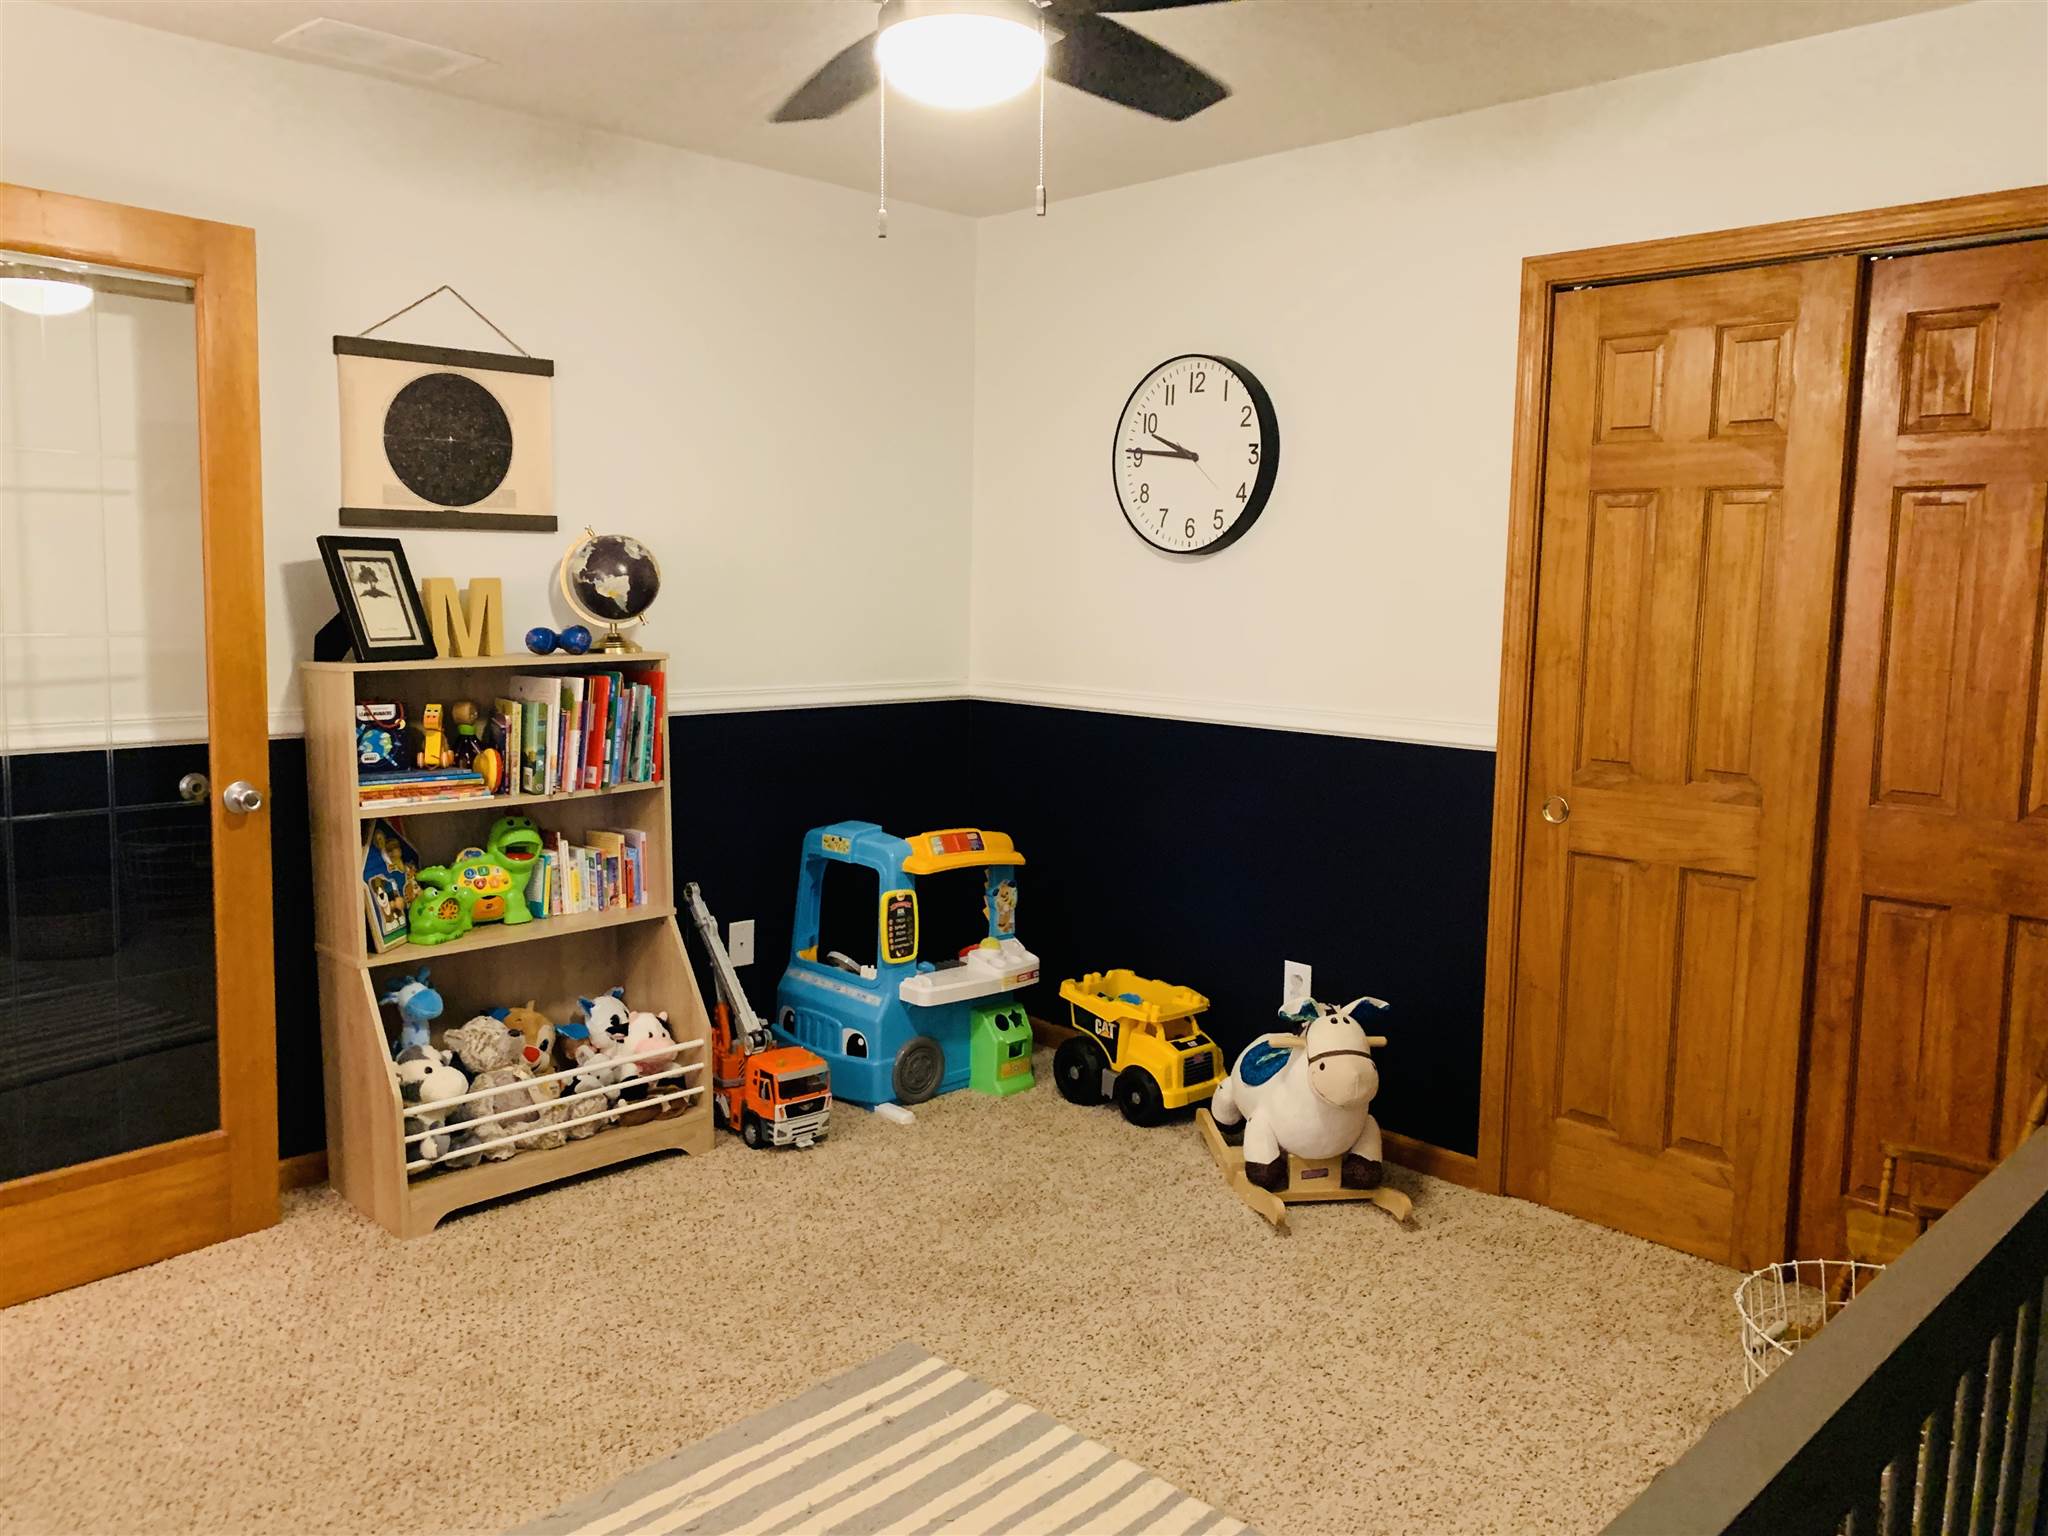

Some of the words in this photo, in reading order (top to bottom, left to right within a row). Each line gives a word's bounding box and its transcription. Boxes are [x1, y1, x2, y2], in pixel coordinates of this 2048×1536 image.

[1189, 371, 1206, 393] 12
[1224, 379, 1229, 402] 1
[1165, 384, 1175, 406] 11
[1143, 413, 1158, 434] 10
[1240, 405, 1252, 427] 2
[1133, 447, 1143, 468] 9
[1248, 443, 1259, 465] 3
[1139, 483, 1150, 504] 8
[1236, 482, 1247, 503] 4
[1159, 508, 1169, 529] 7
[1184, 518, 1195, 539] 6
[1213, 509, 1224, 530] 5
[421, 577, 504, 657] M
[1095, 1018, 1117, 1039] CAT
